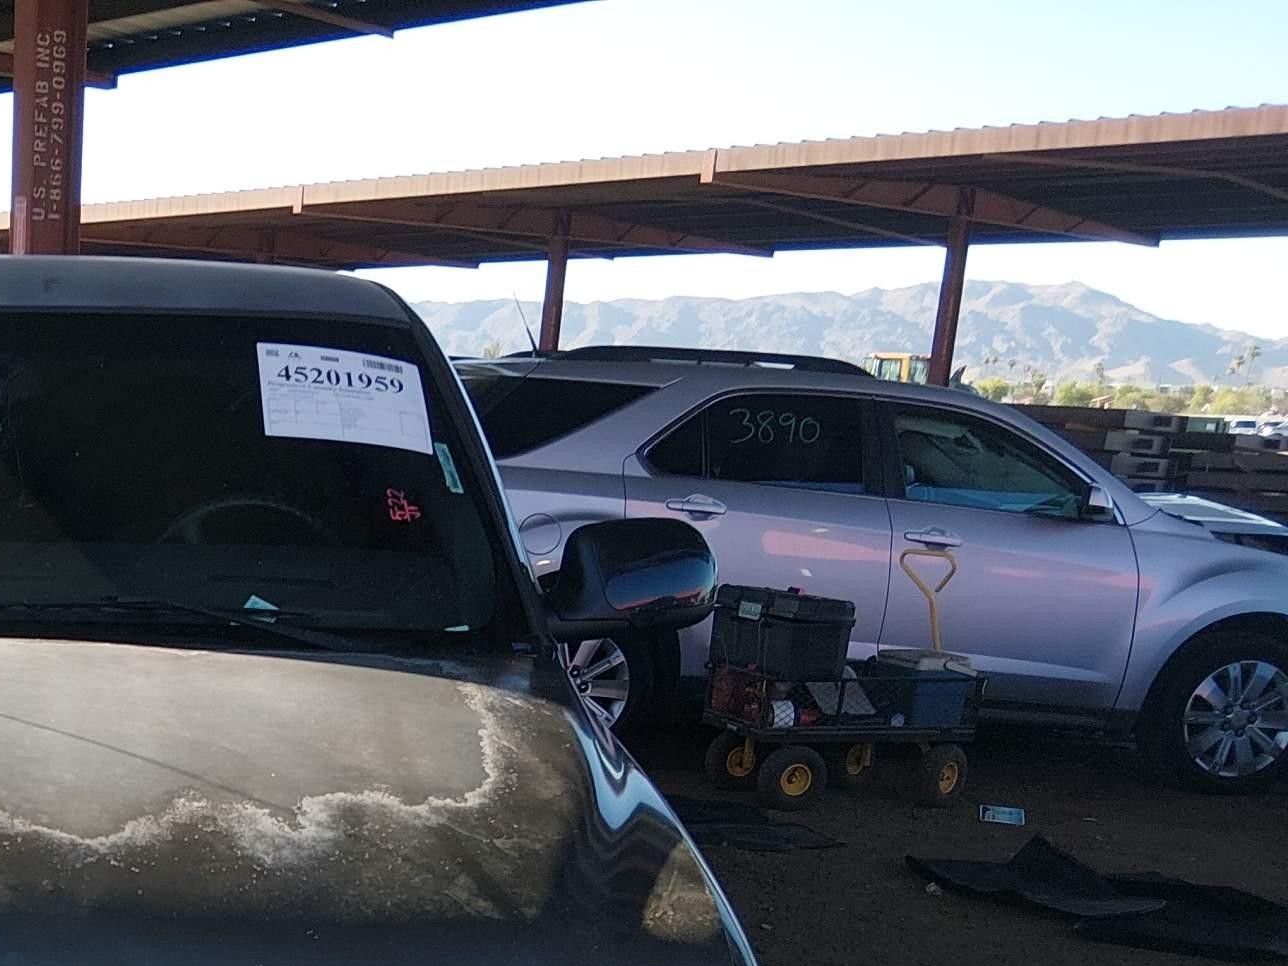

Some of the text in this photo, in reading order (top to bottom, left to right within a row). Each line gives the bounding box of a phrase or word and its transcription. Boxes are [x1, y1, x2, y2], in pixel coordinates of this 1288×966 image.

[33, 80, 49, 168] PREFAB
[48, 29, 67, 221] 1-866-799-0969
[32, 180, 46, 221] U.S.
[277, 364, 404, 394] 45201959
[729, 408, 820, 444] 3890
